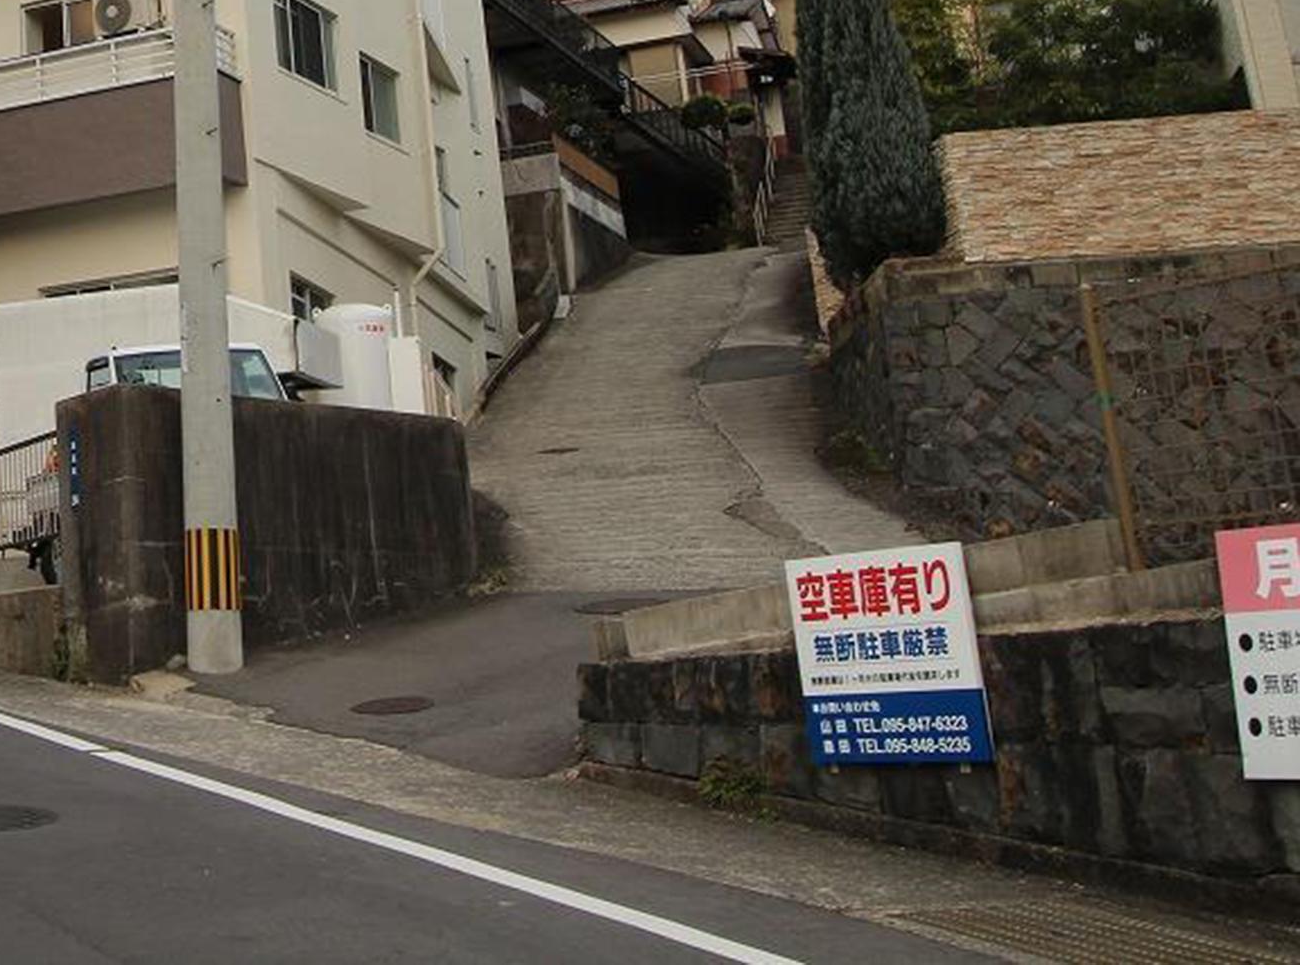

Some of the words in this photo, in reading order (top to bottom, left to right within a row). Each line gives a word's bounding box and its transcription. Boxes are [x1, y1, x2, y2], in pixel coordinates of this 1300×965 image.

[795, 559, 950, 622] 空車庫有り
[1255, 536, 1300, 599] 月
[813, 626, 949, 662] 無断駐車厳禁
